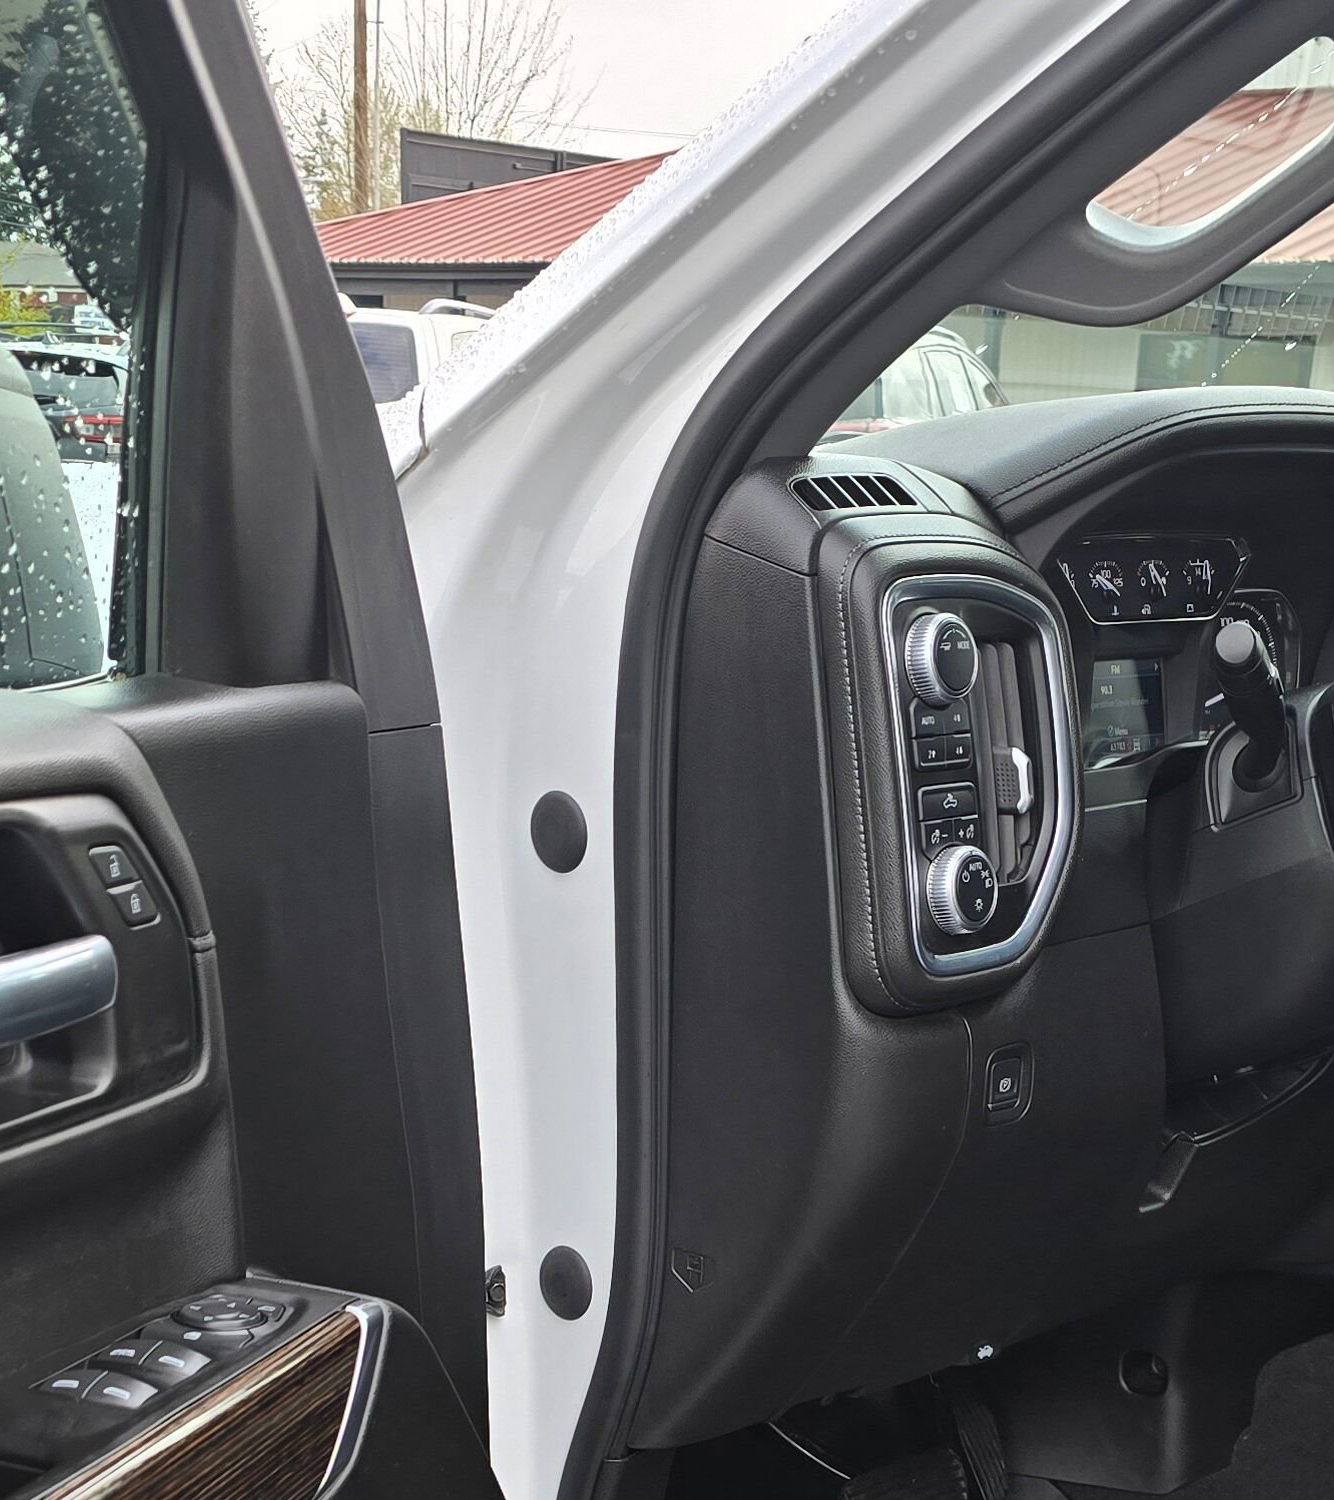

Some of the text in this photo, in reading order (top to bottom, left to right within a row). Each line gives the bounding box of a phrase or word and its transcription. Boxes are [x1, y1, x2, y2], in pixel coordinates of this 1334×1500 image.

[957, 641, 971, 650] MODE
[1110, 664, 1121, 675] FM
[921, 716, 936, 726] AUTO
[969, 862, 983, 871] AUTO
